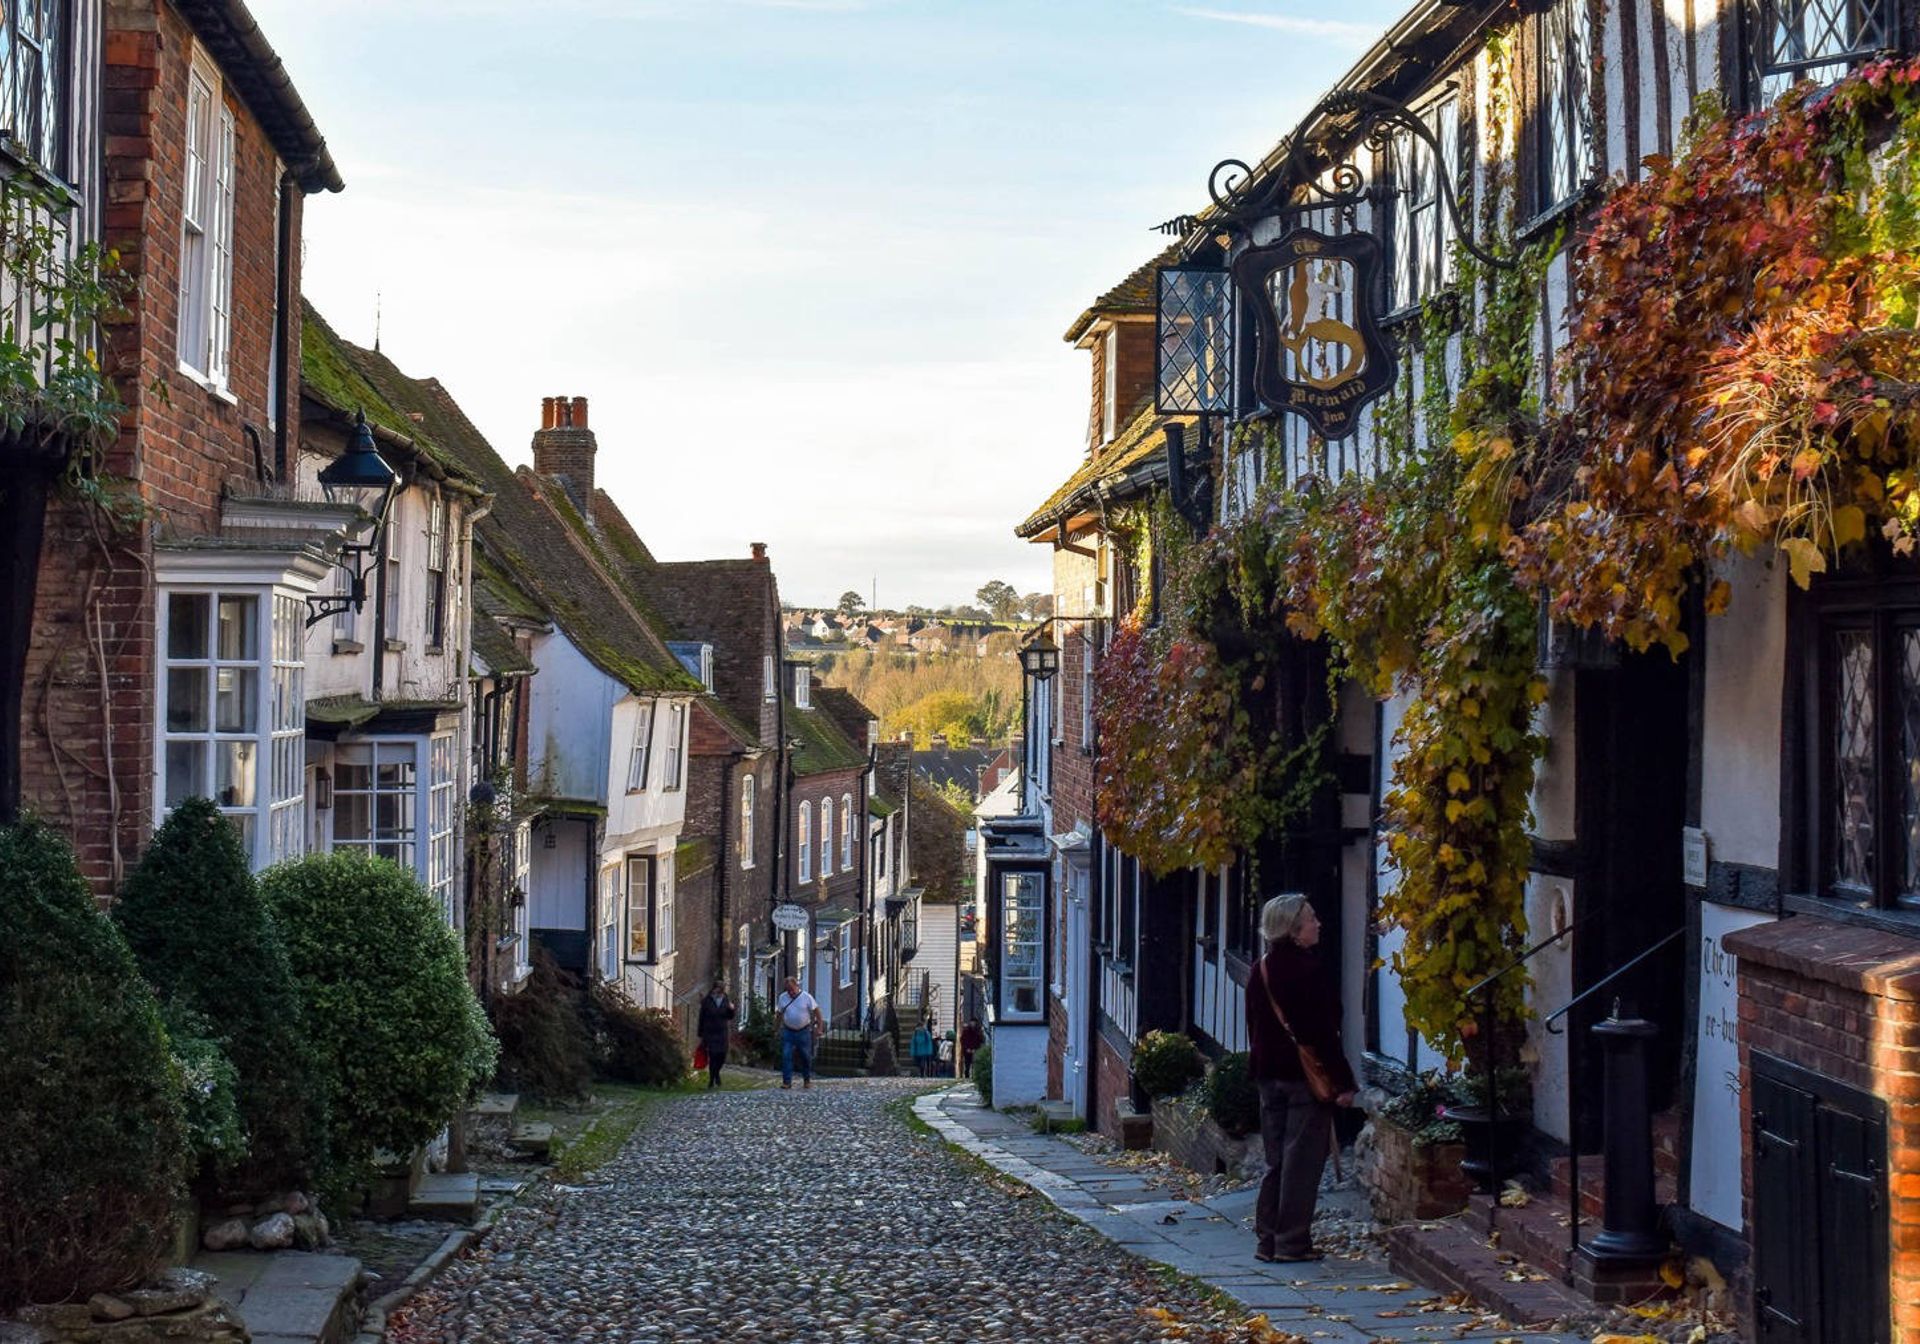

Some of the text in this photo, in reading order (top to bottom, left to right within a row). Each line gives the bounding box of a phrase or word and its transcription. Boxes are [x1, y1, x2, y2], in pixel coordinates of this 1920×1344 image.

[1292, 238, 1323, 255] The
[1288, 379, 1366, 406] Mermaid
[1322, 410, 1346, 427] Inn
[1704, 936, 1724, 977] The
